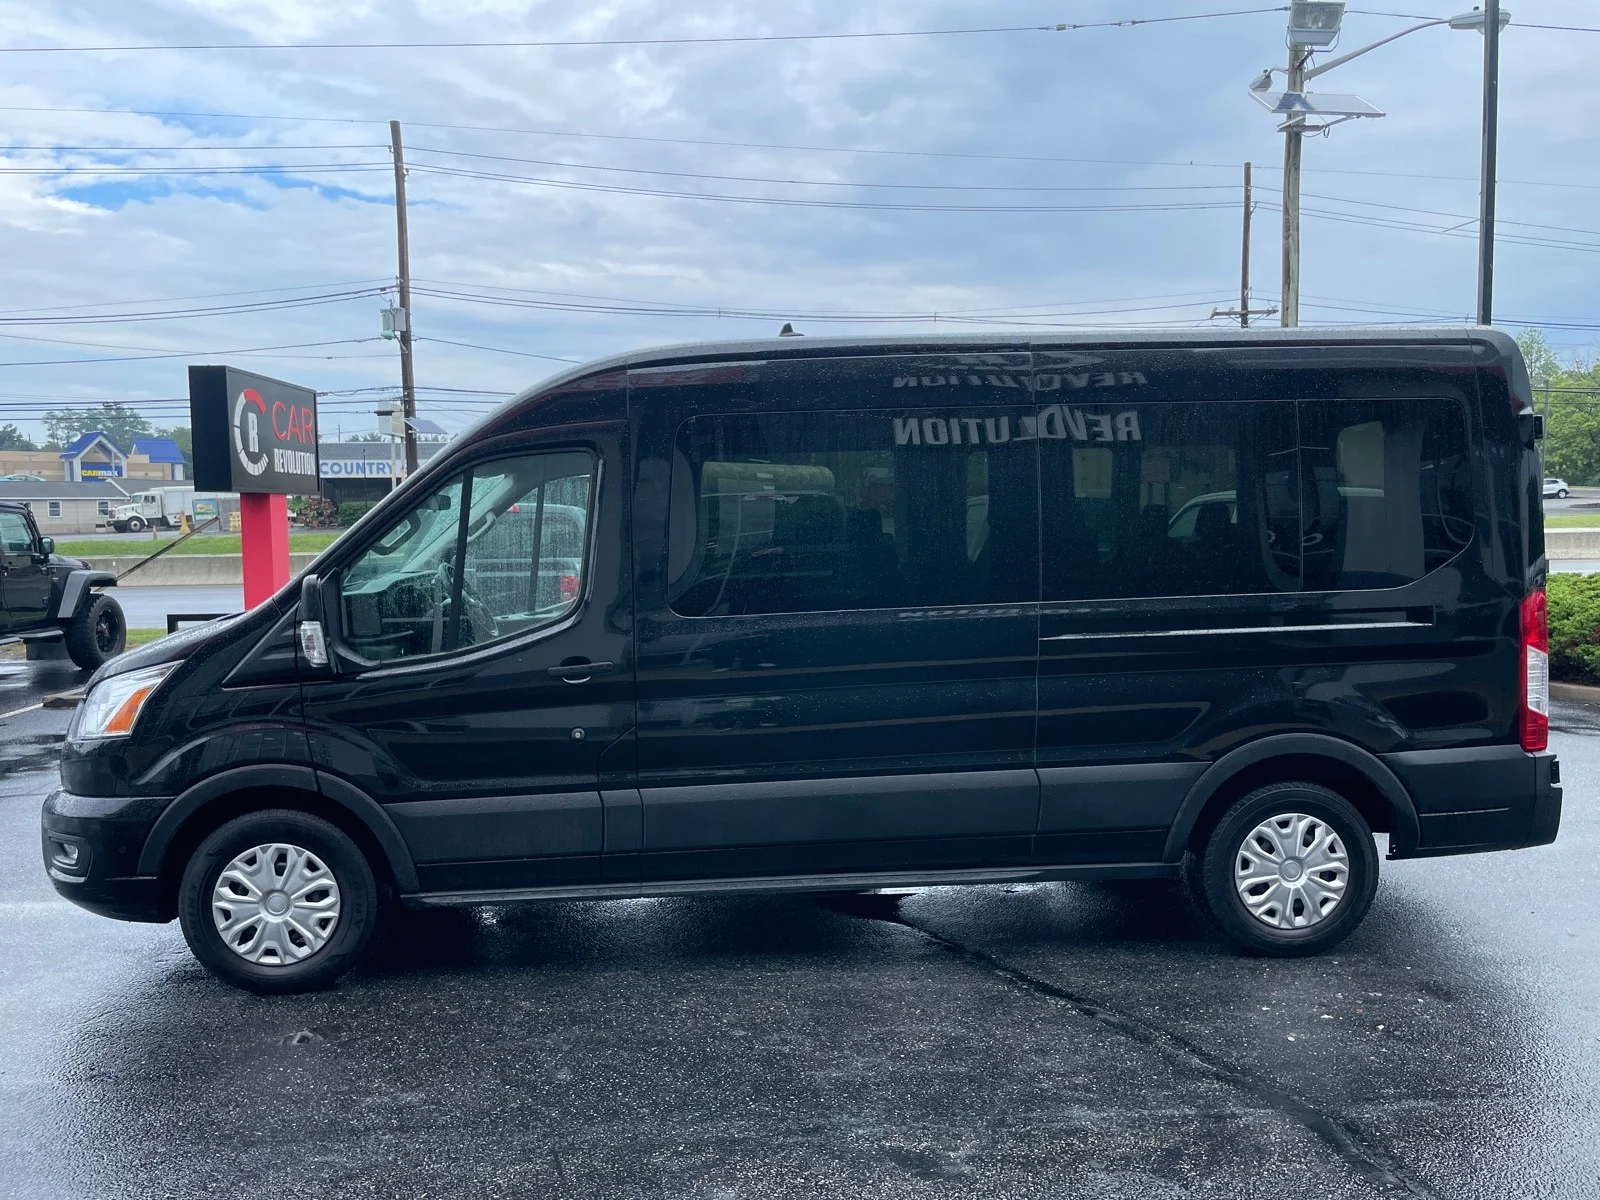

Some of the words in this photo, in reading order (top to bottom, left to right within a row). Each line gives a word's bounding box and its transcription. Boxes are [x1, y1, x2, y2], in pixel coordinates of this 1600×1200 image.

[272, 401, 314, 445] CAR
[274, 448, 316, 476] REVOLUTION
[320, 462, 393, 475] COUNTRY
